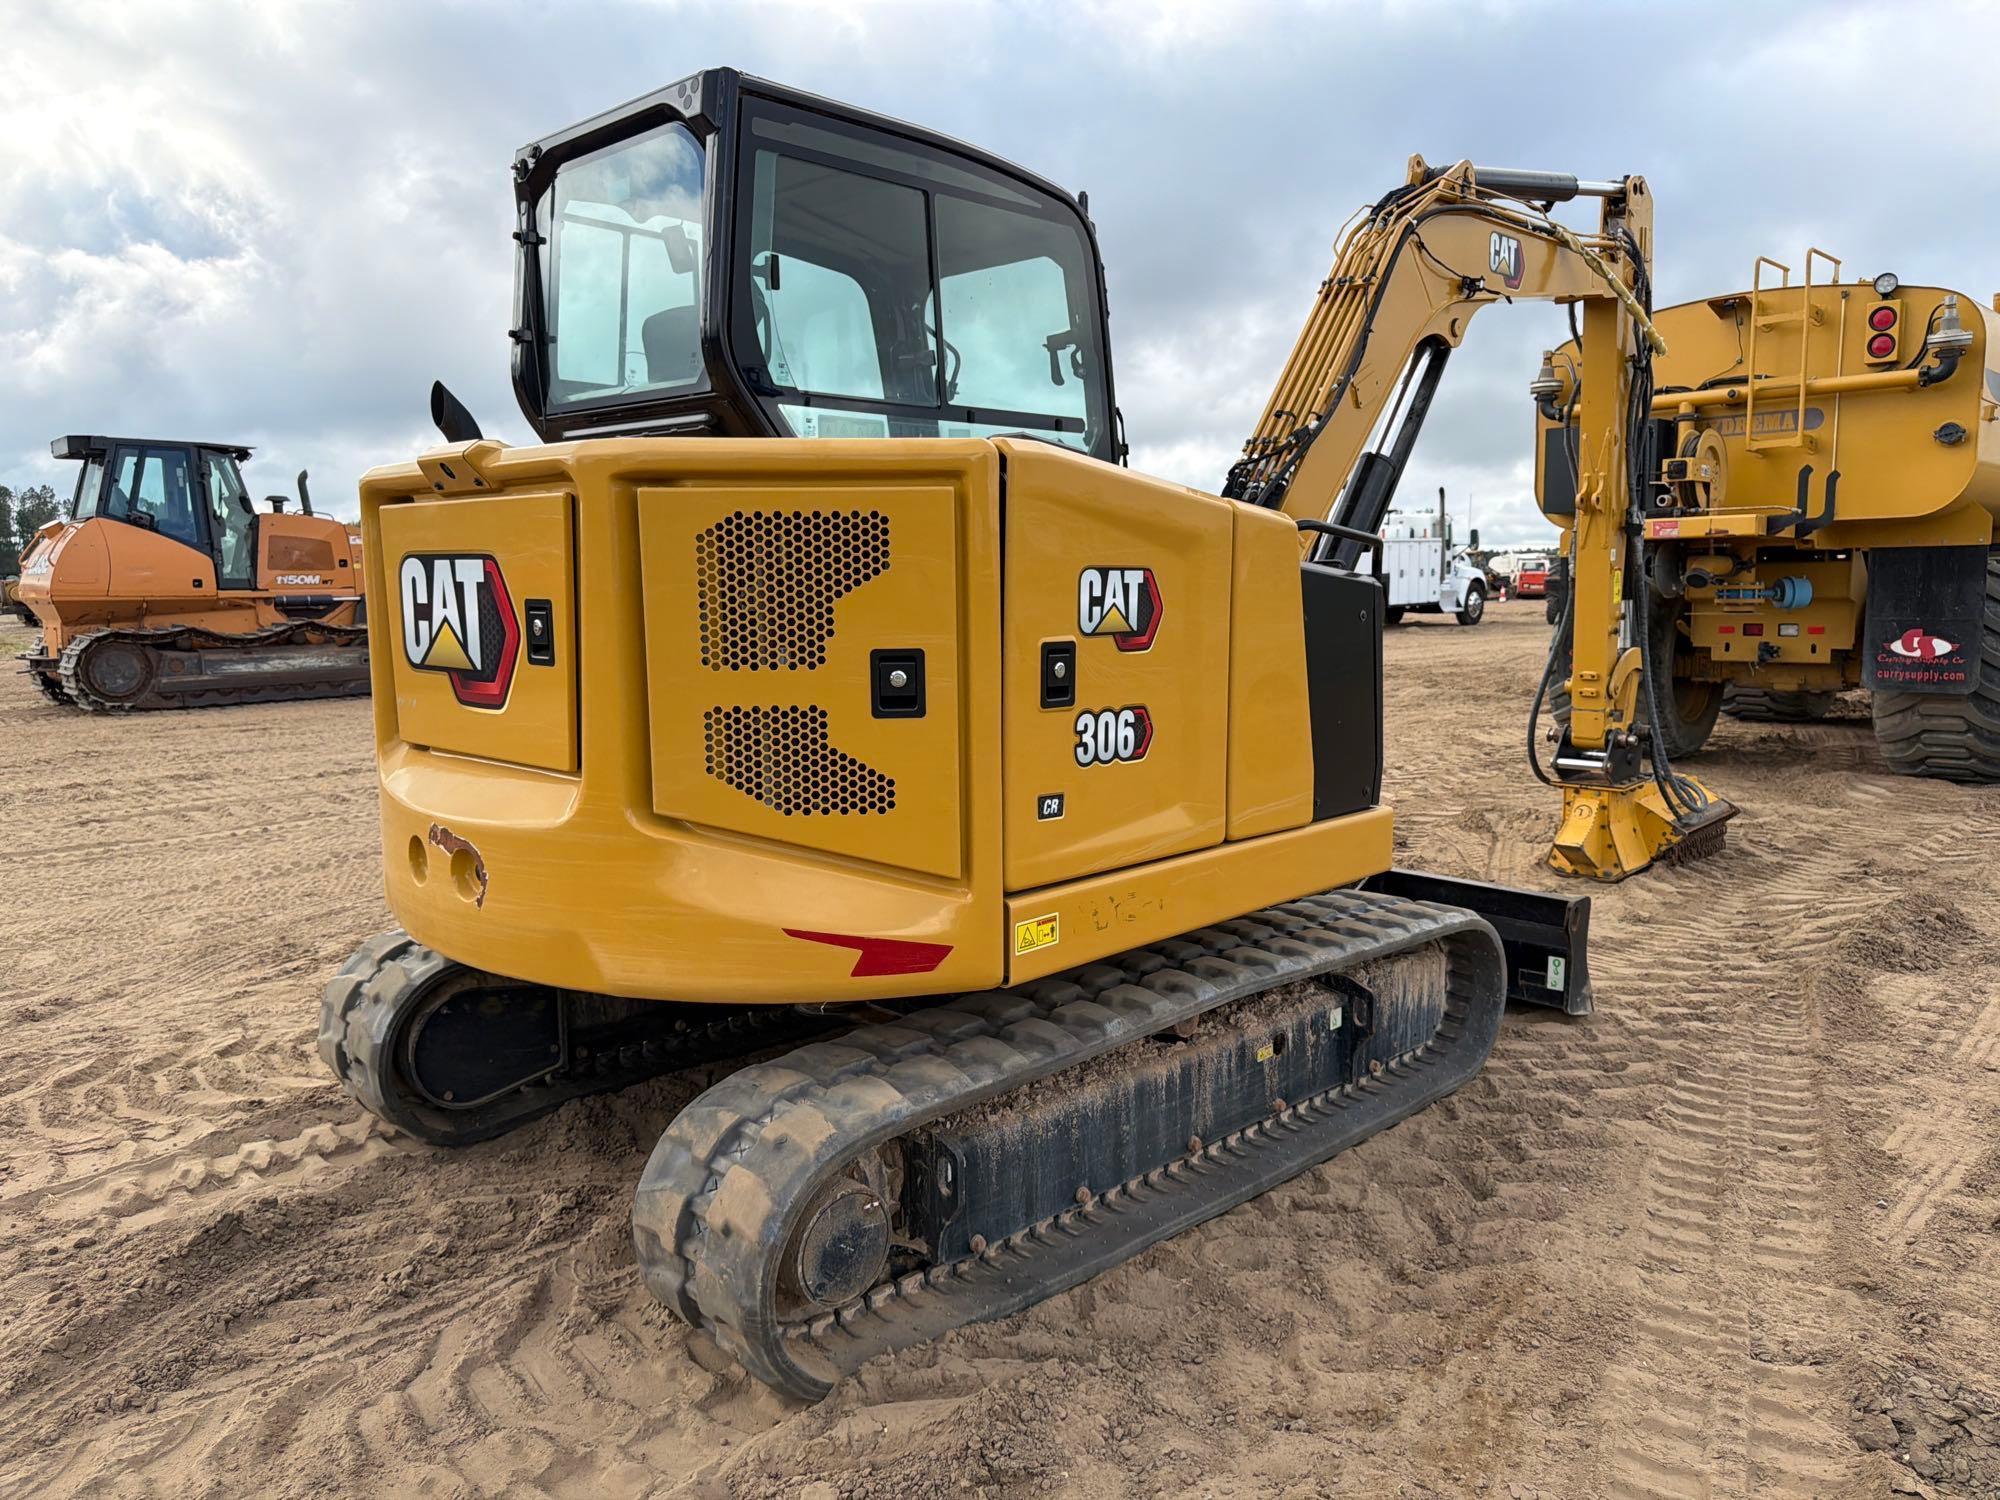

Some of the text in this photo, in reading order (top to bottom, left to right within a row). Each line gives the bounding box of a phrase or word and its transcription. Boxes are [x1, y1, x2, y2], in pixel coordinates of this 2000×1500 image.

[1490, 231, 1518, 278] CAT
[276, 575, 321, 585] 1150M
[1080, 568, 1144, 634] CAT
[401, 557, 485, 671] CAT
[1877, 668, 1965, 682] currysupply.com
[1076, 709, 1135, 764] 306
[1043, 798, 1059, 815] CR
